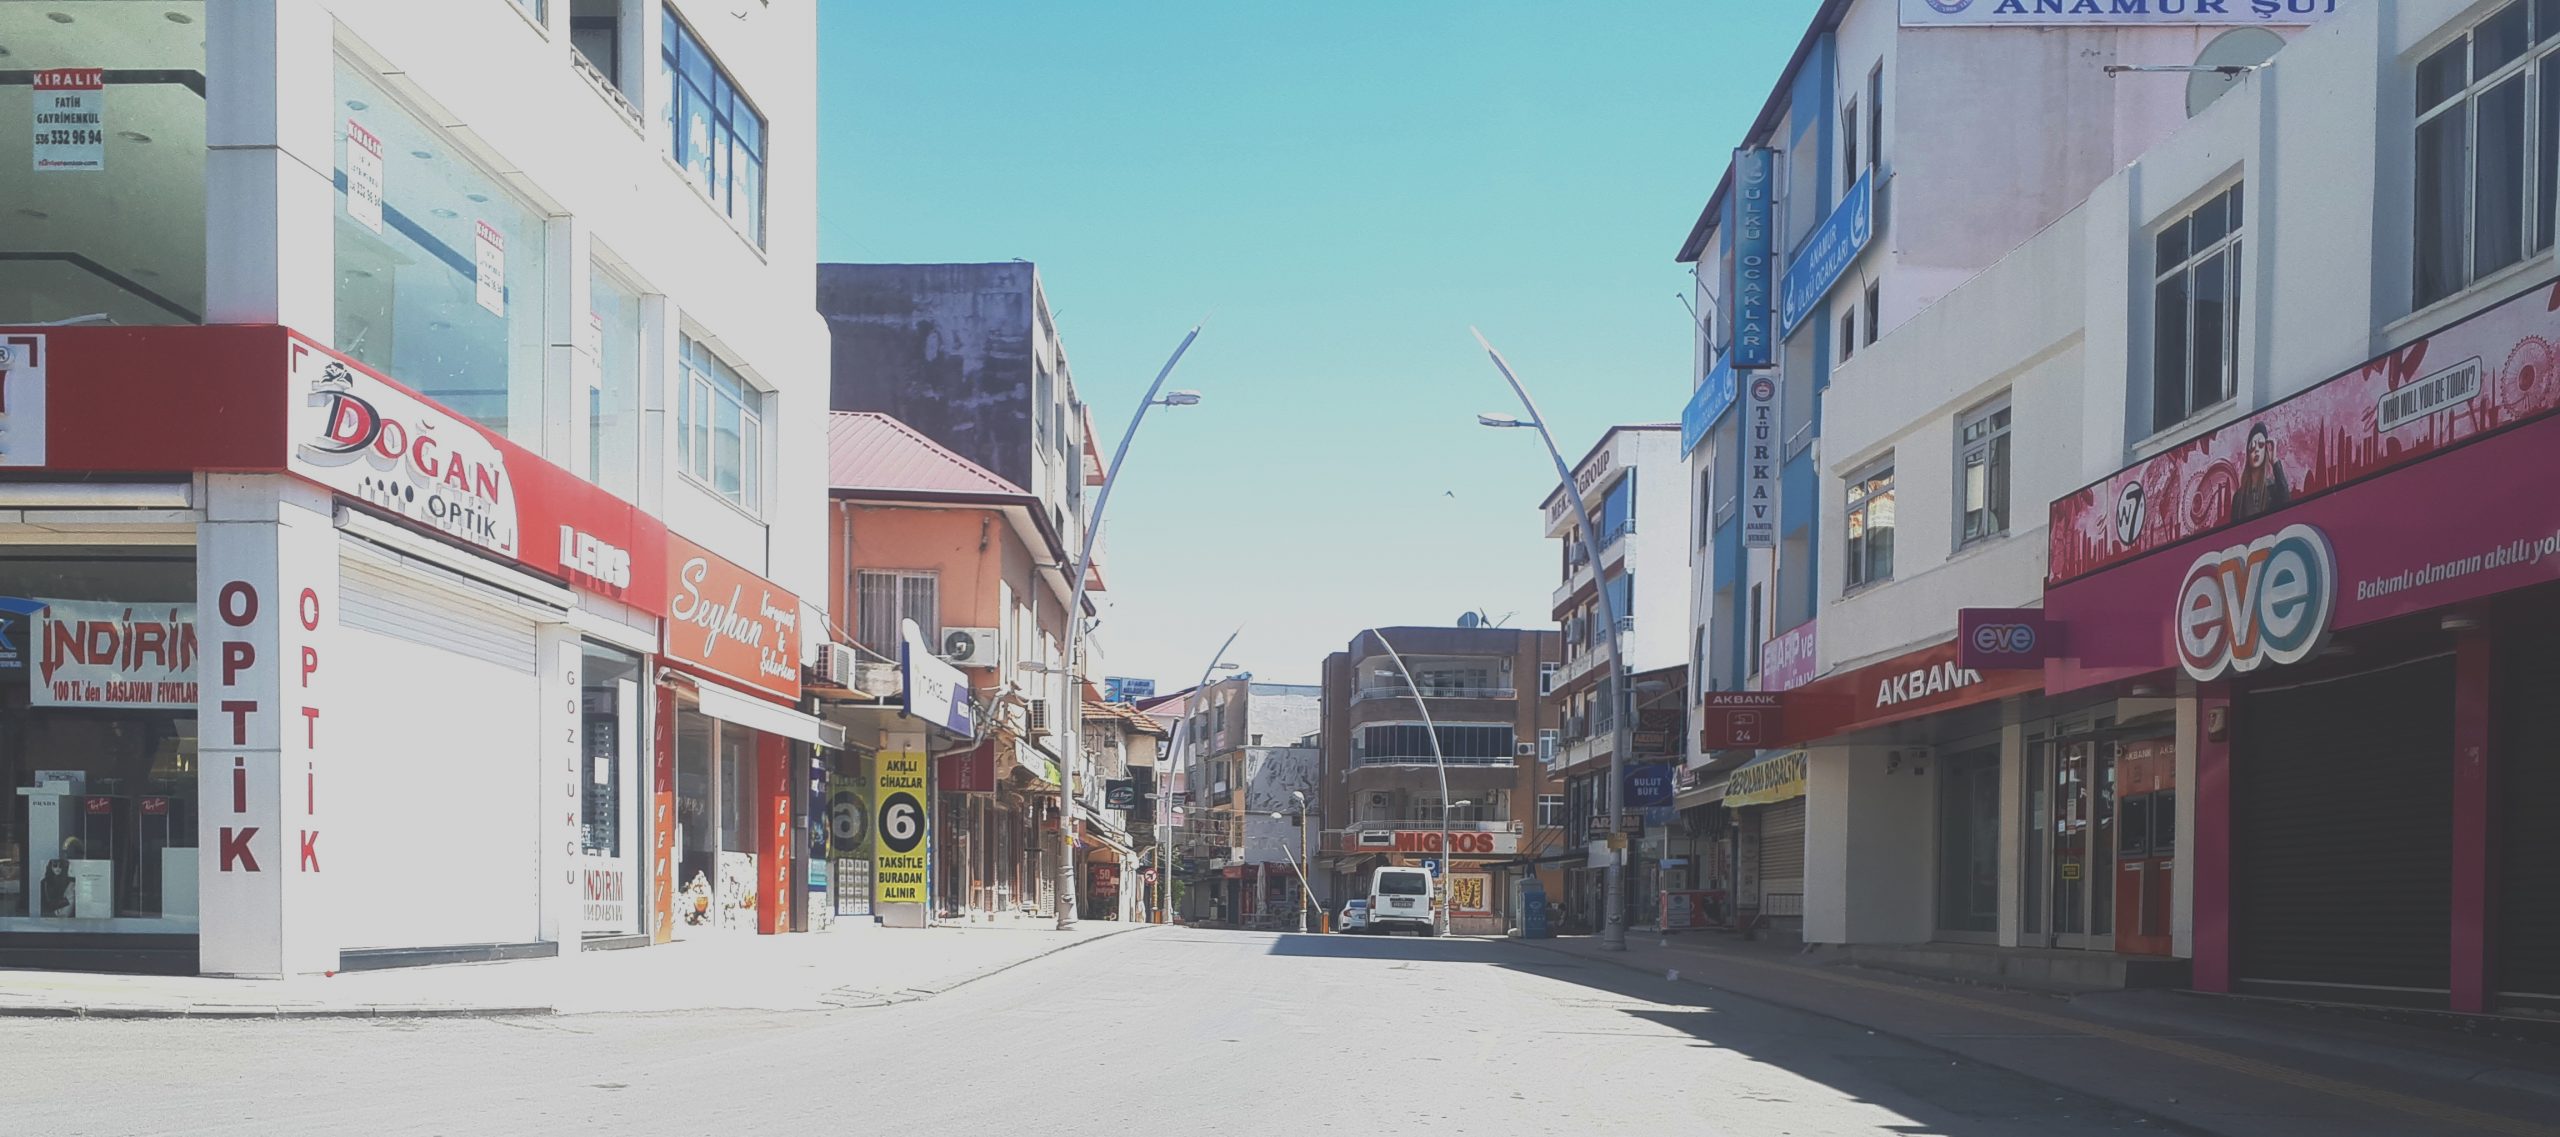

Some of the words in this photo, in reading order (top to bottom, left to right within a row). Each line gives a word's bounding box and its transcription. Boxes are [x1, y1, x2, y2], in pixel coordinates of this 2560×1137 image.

[33, 73, 102, 86] KİRALIK
[55, 95, 81, 108] FATİH
[36, 111, 100, 124] GAYRİMENKUL
[35, 133, 49, 144] 536
[51, 129, 70, 144] 332
[72, 129, 86, 144] 96
[88, 129, 102, 144] 94
[1809, 223, 1837, 272] ANAMUR
[1743, 255, 1762, 359] OCAKLARI
[2383, 395, 2399, 425] WHO
[2401, 388, 2417, 418] WILL
[2419, 382, 2434, 411] YOU
[2435, 377, 2445, 405] BE
[2446, 365, 2476, 401] TODAY?
[306, 390, 500, 505] DOĞAN
[1579, 449, 1610, 495] GROUP
[1752, 406, 1770, 519] TÜRKAV
[428, 494, 496, 540] OPTİK
[560, 525, 631, 590] LENS
[2357, 569, 2413, 601] Bakımlı
[2415, 554, 2481, 586] olmanın
[2484, 538, 2531, 569] akıllı
[672, 557, 763, 658] Seyhan
[2178, 537, 2319, 669] eve
[1975, 626, 2034, 651] eve
[53, 681, 69, 701] 100
[1713, 695, 1776, 705] AKBANK
[218, 580, 261, 872] OPTİK
[299, 587, 320, 873] OPTİK
[1736, 729, 1751, 741] 24
[886, 760, 917, 772] AKILLI
[880, 775, 923, 788] CİHAZLAR
[1634, 777, 1661, 787] BULUT
[886, 803, 916, 840] 6
[1395, 832, 1494, 853] MIGROS
[879, 855, 923, 869] TAKSİTLE
[878, 873, 922, 884] BURADAN
[884, 887, 916, 898] ALINIR
